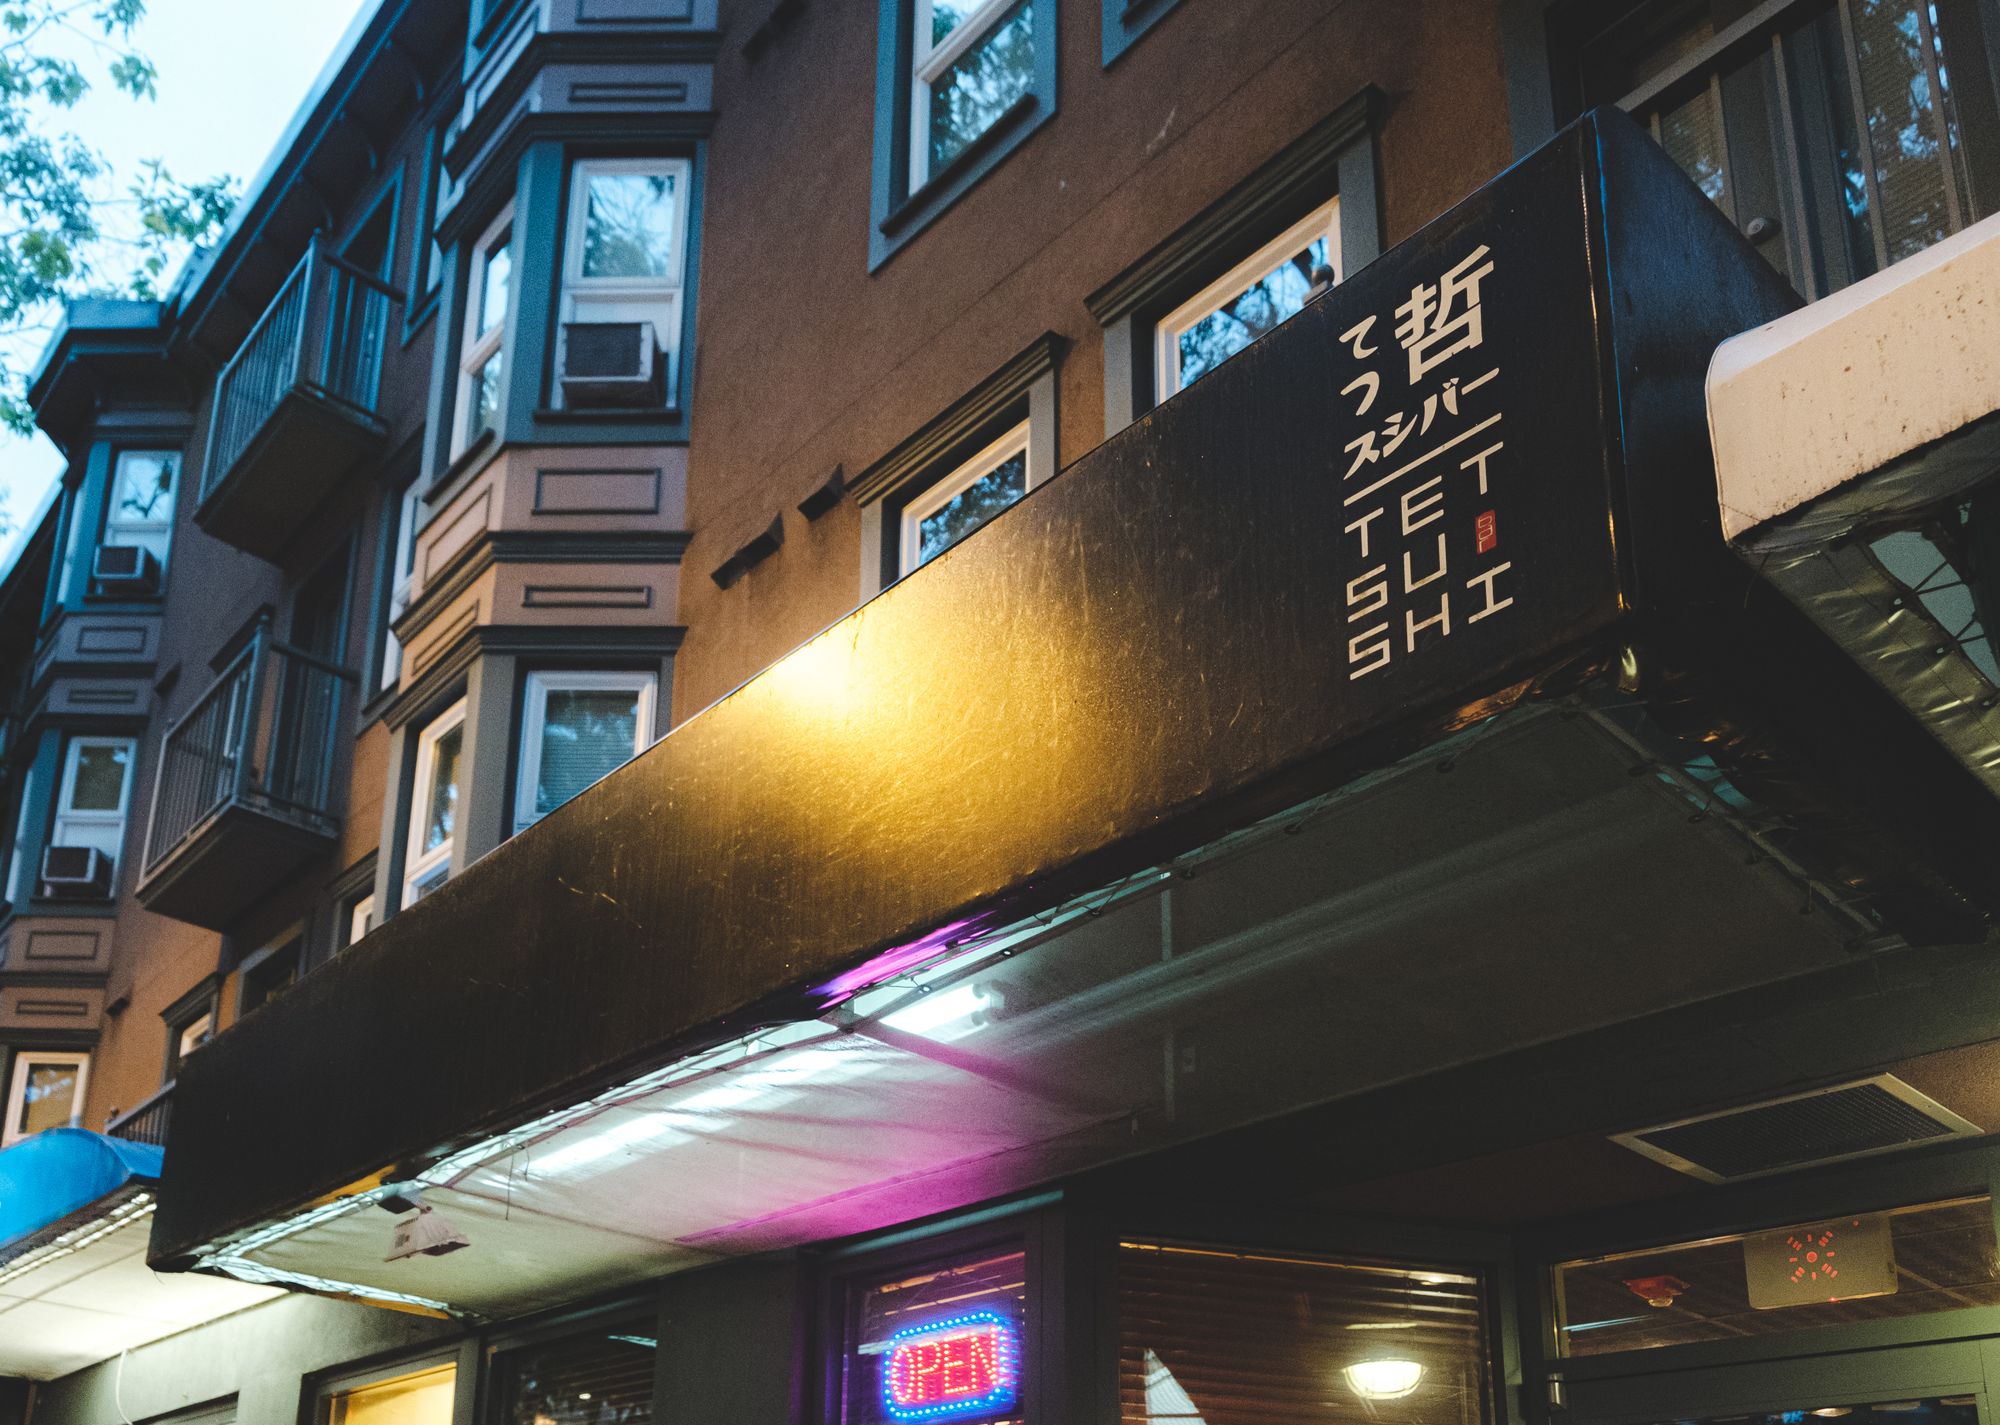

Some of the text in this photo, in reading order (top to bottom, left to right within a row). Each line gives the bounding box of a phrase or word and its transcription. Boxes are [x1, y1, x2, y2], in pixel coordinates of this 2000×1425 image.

[1395, 244, 1494, 385] 哲
[1343, 367, 1499, 480] スシバー
[891, 1326, 998, 1402] OPEN
